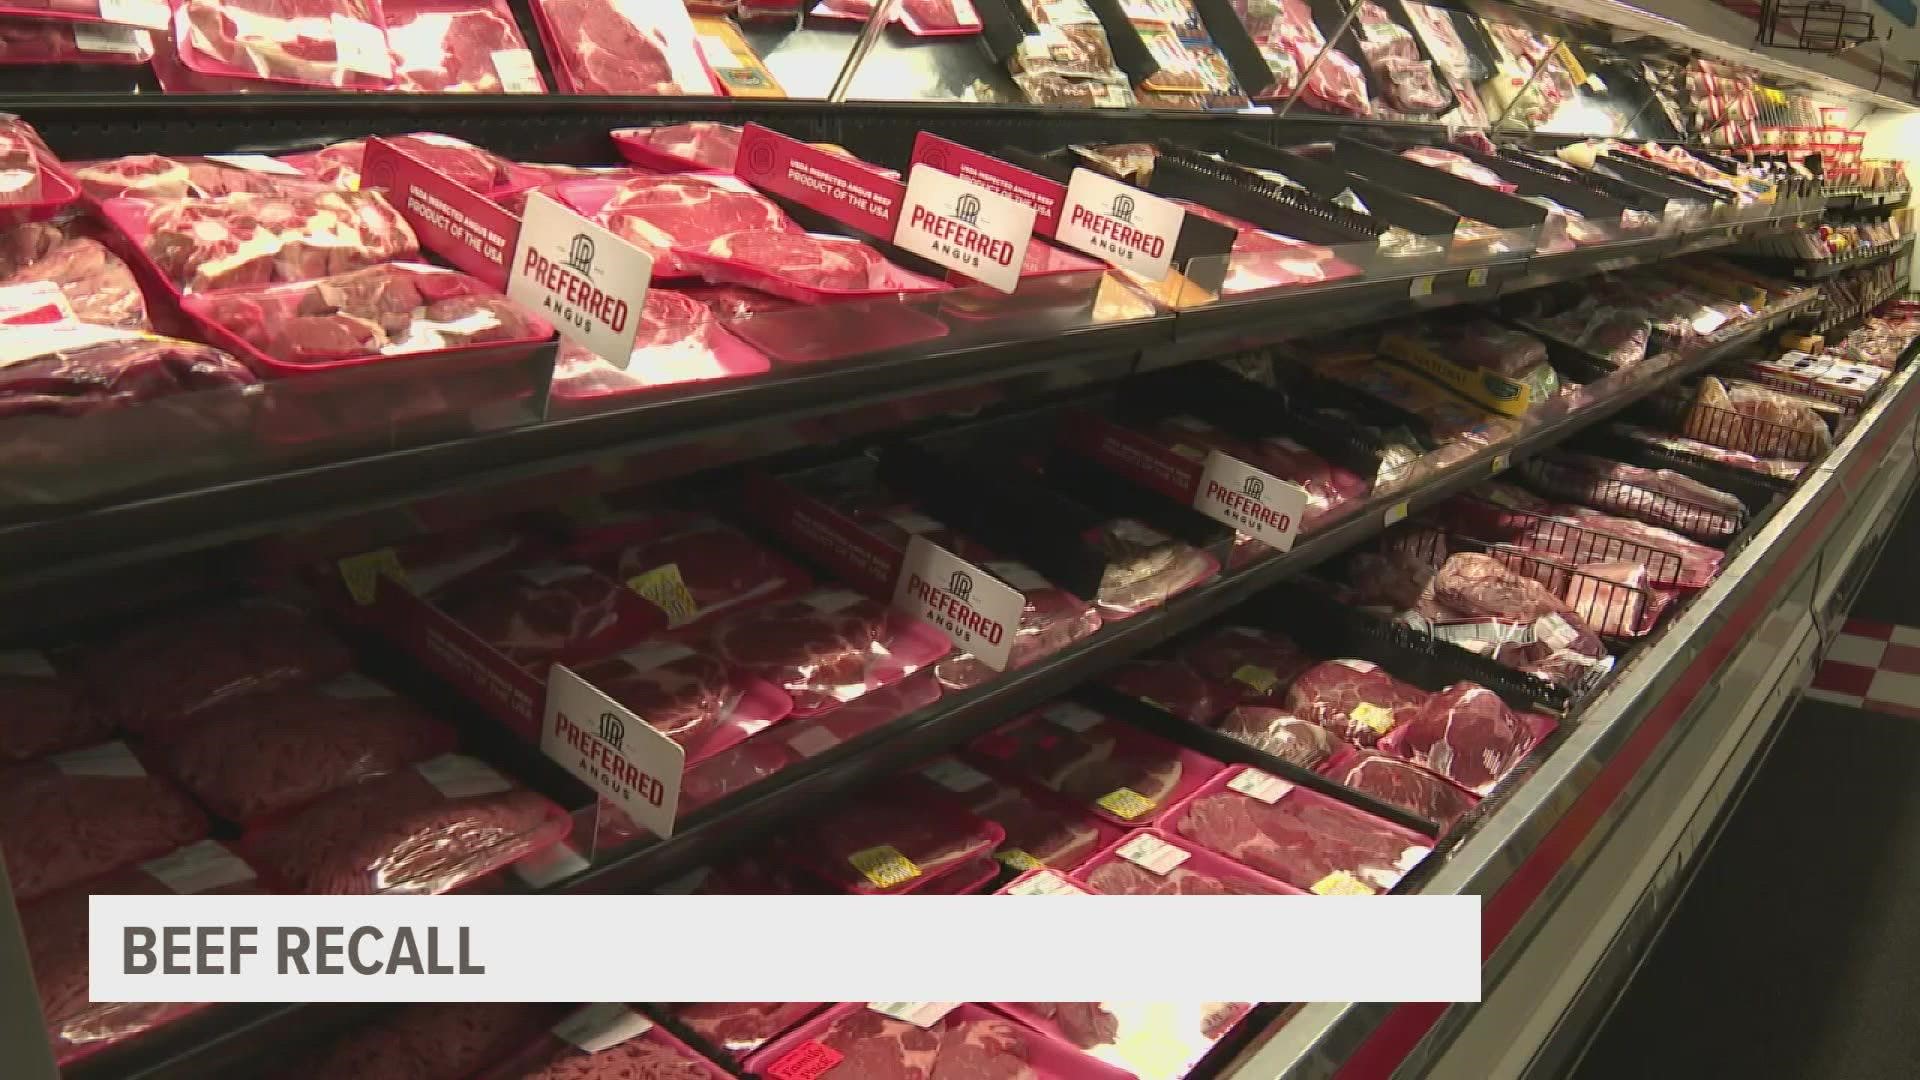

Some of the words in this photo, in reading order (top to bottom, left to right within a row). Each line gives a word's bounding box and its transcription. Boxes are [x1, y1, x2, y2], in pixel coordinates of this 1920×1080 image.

[788, 168, 833, 196] PRODUCT
[833, 187, 848, 200] OF
[848, 194, 867, 211] THE
[869, 202, 889, 221] USA
[848, 183, 873, 199] ANGUS
[873, 193, 892, 206] BEEF
[408, 197, 450, 230] PRODUCT
[450, 222, 464, 239] OF
[465, 231, 482, 252] THE
[484, 242, 504, 264] USA
[911, 203, 1015, 266] PREFERRED
[932, 240, 979, 268] ANGUS
[1071, 204, 1165, 259] PREFERRED
[1091, 235, 1134, 259] ANGUS
[524, 246, 629, 333] PREFERRED
[543, 297, 592, 333] ANGUS
[1207, 480, 1291, 534] PREFERRED
[1224, 509, 1262, 532] ANGUS
[908, 573, 1003, 645] PREFERRED
[927, 610, 971, 642] ANGUS
[555, 711, 664, 807] PREFERRED
[579, 759, 630, 800] ANGUS
